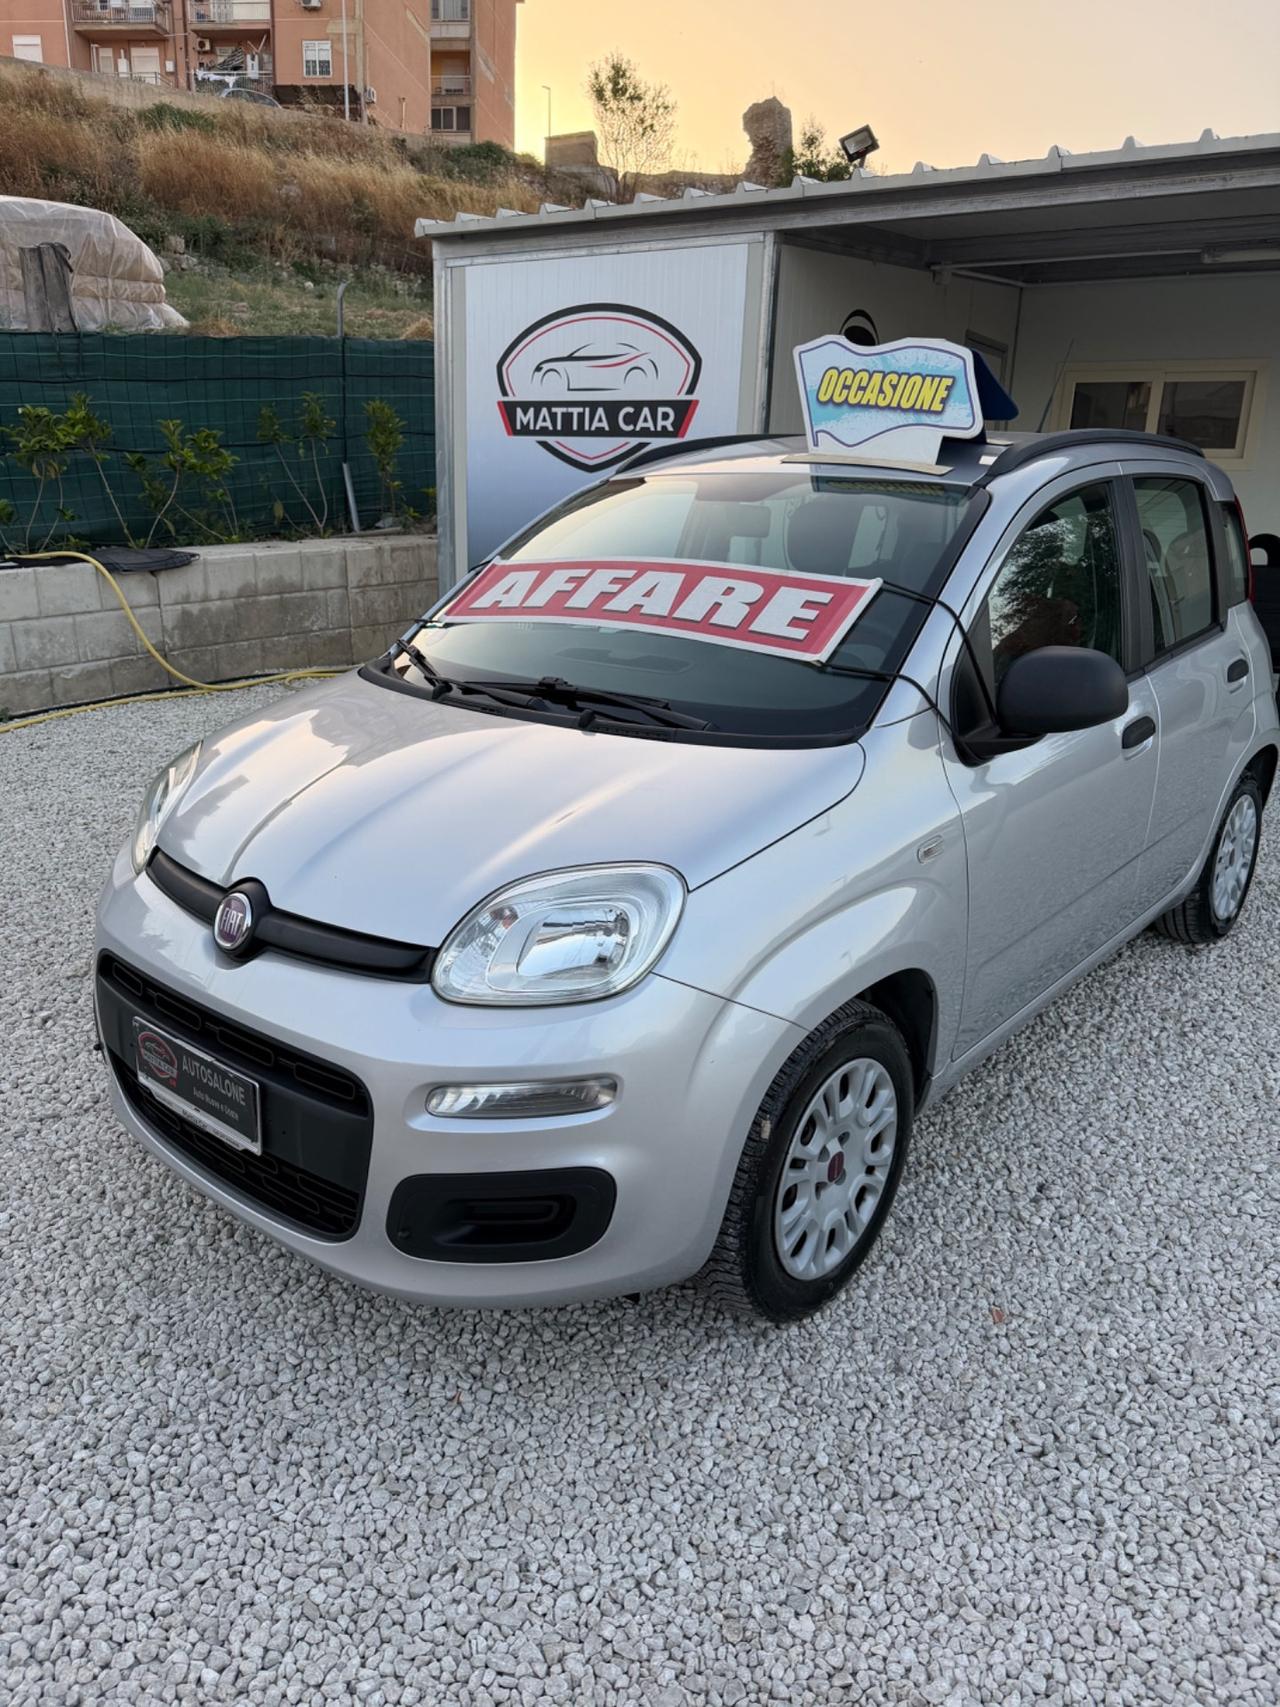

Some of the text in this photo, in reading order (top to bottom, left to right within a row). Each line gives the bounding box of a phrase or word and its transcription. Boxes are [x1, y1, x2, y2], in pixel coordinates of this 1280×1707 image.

[816, 367, 955, 413] OCCASIONE
[515, 406, 675, 432] MATTIA CAR
[469, 568, 834, 641] AFFARE
[220, 907, 244, 936] FIAT
[182, 1055, 246, 1106] AUTOSALONE
